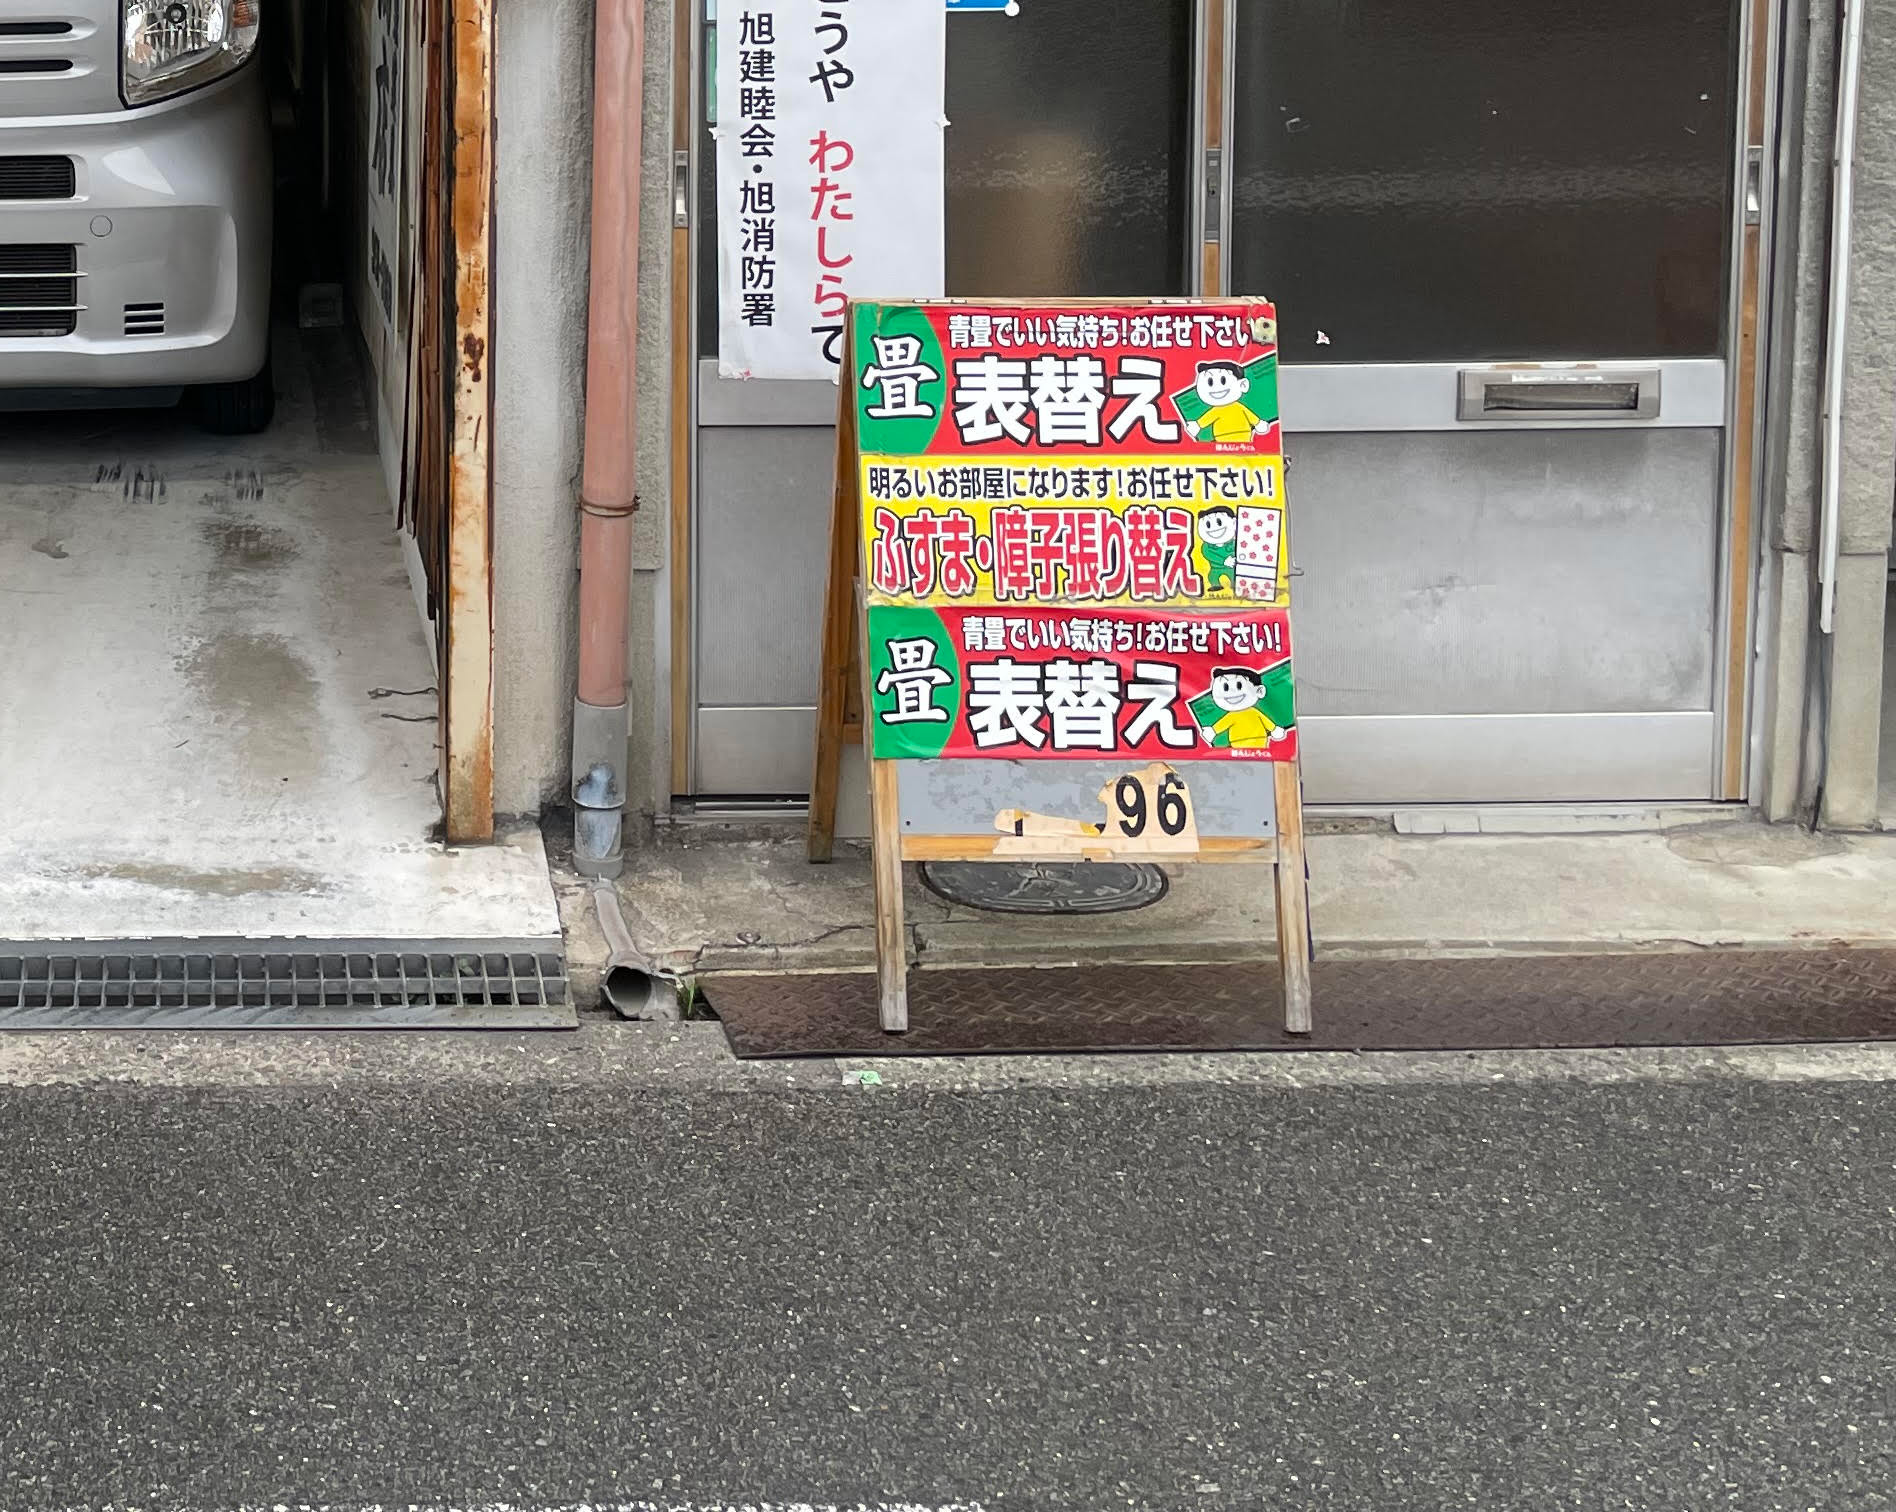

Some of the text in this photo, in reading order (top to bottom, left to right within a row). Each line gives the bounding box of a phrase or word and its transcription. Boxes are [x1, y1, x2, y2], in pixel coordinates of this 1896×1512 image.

[738, 10, 777, 327] 旭建睦会・旭消防署
[862, 335, 938, 420] 畳
[952, 355, 1181, 445] 表替え
[869, 466, 1274, 501] 明るいお部屋になります!お任せ下さい!
[872, 506, 1203, 601] ふすま・障子張り替え
[962, 615, 1282, 655] 青畳でいい気持ち!お任せ下さい!
[877, 638, 955, 725] 畳
[966, 658, 1196, 751] 表替え
[1115, 773, 1187, 838] 96
